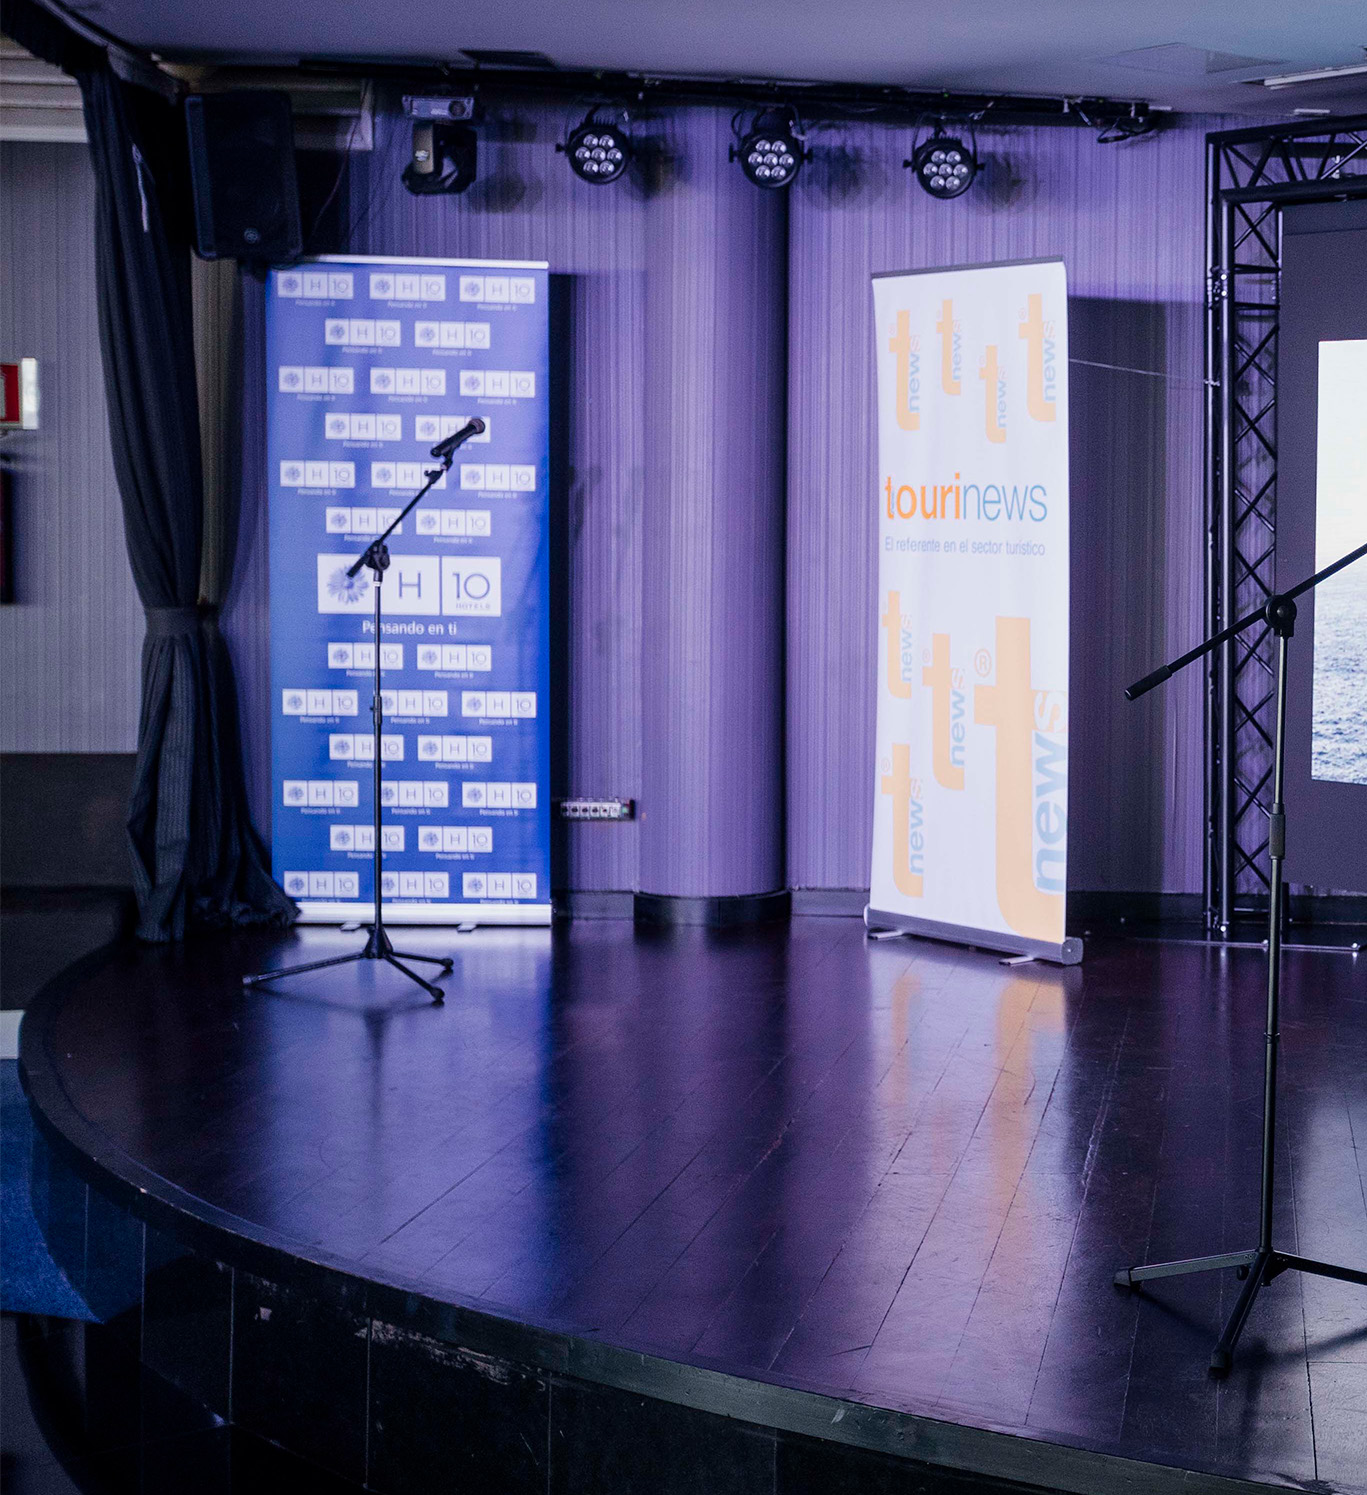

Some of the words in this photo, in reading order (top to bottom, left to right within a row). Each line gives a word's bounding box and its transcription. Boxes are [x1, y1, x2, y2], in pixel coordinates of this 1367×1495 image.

[884, 472, 1048, 522] tourinews
[896, 537, 940, 552] referente
[943, 540, 956, 553] en
[960, 540, 968, 553] el
[972, 540, 1002, 554] sector
[398, 571, 422, 599] H
[452, 572, 491, 600] 10
[362, 619, 425, 636] Pensando
[427, 623, 444, 635] en
[448, 621, 458, 636] ti
